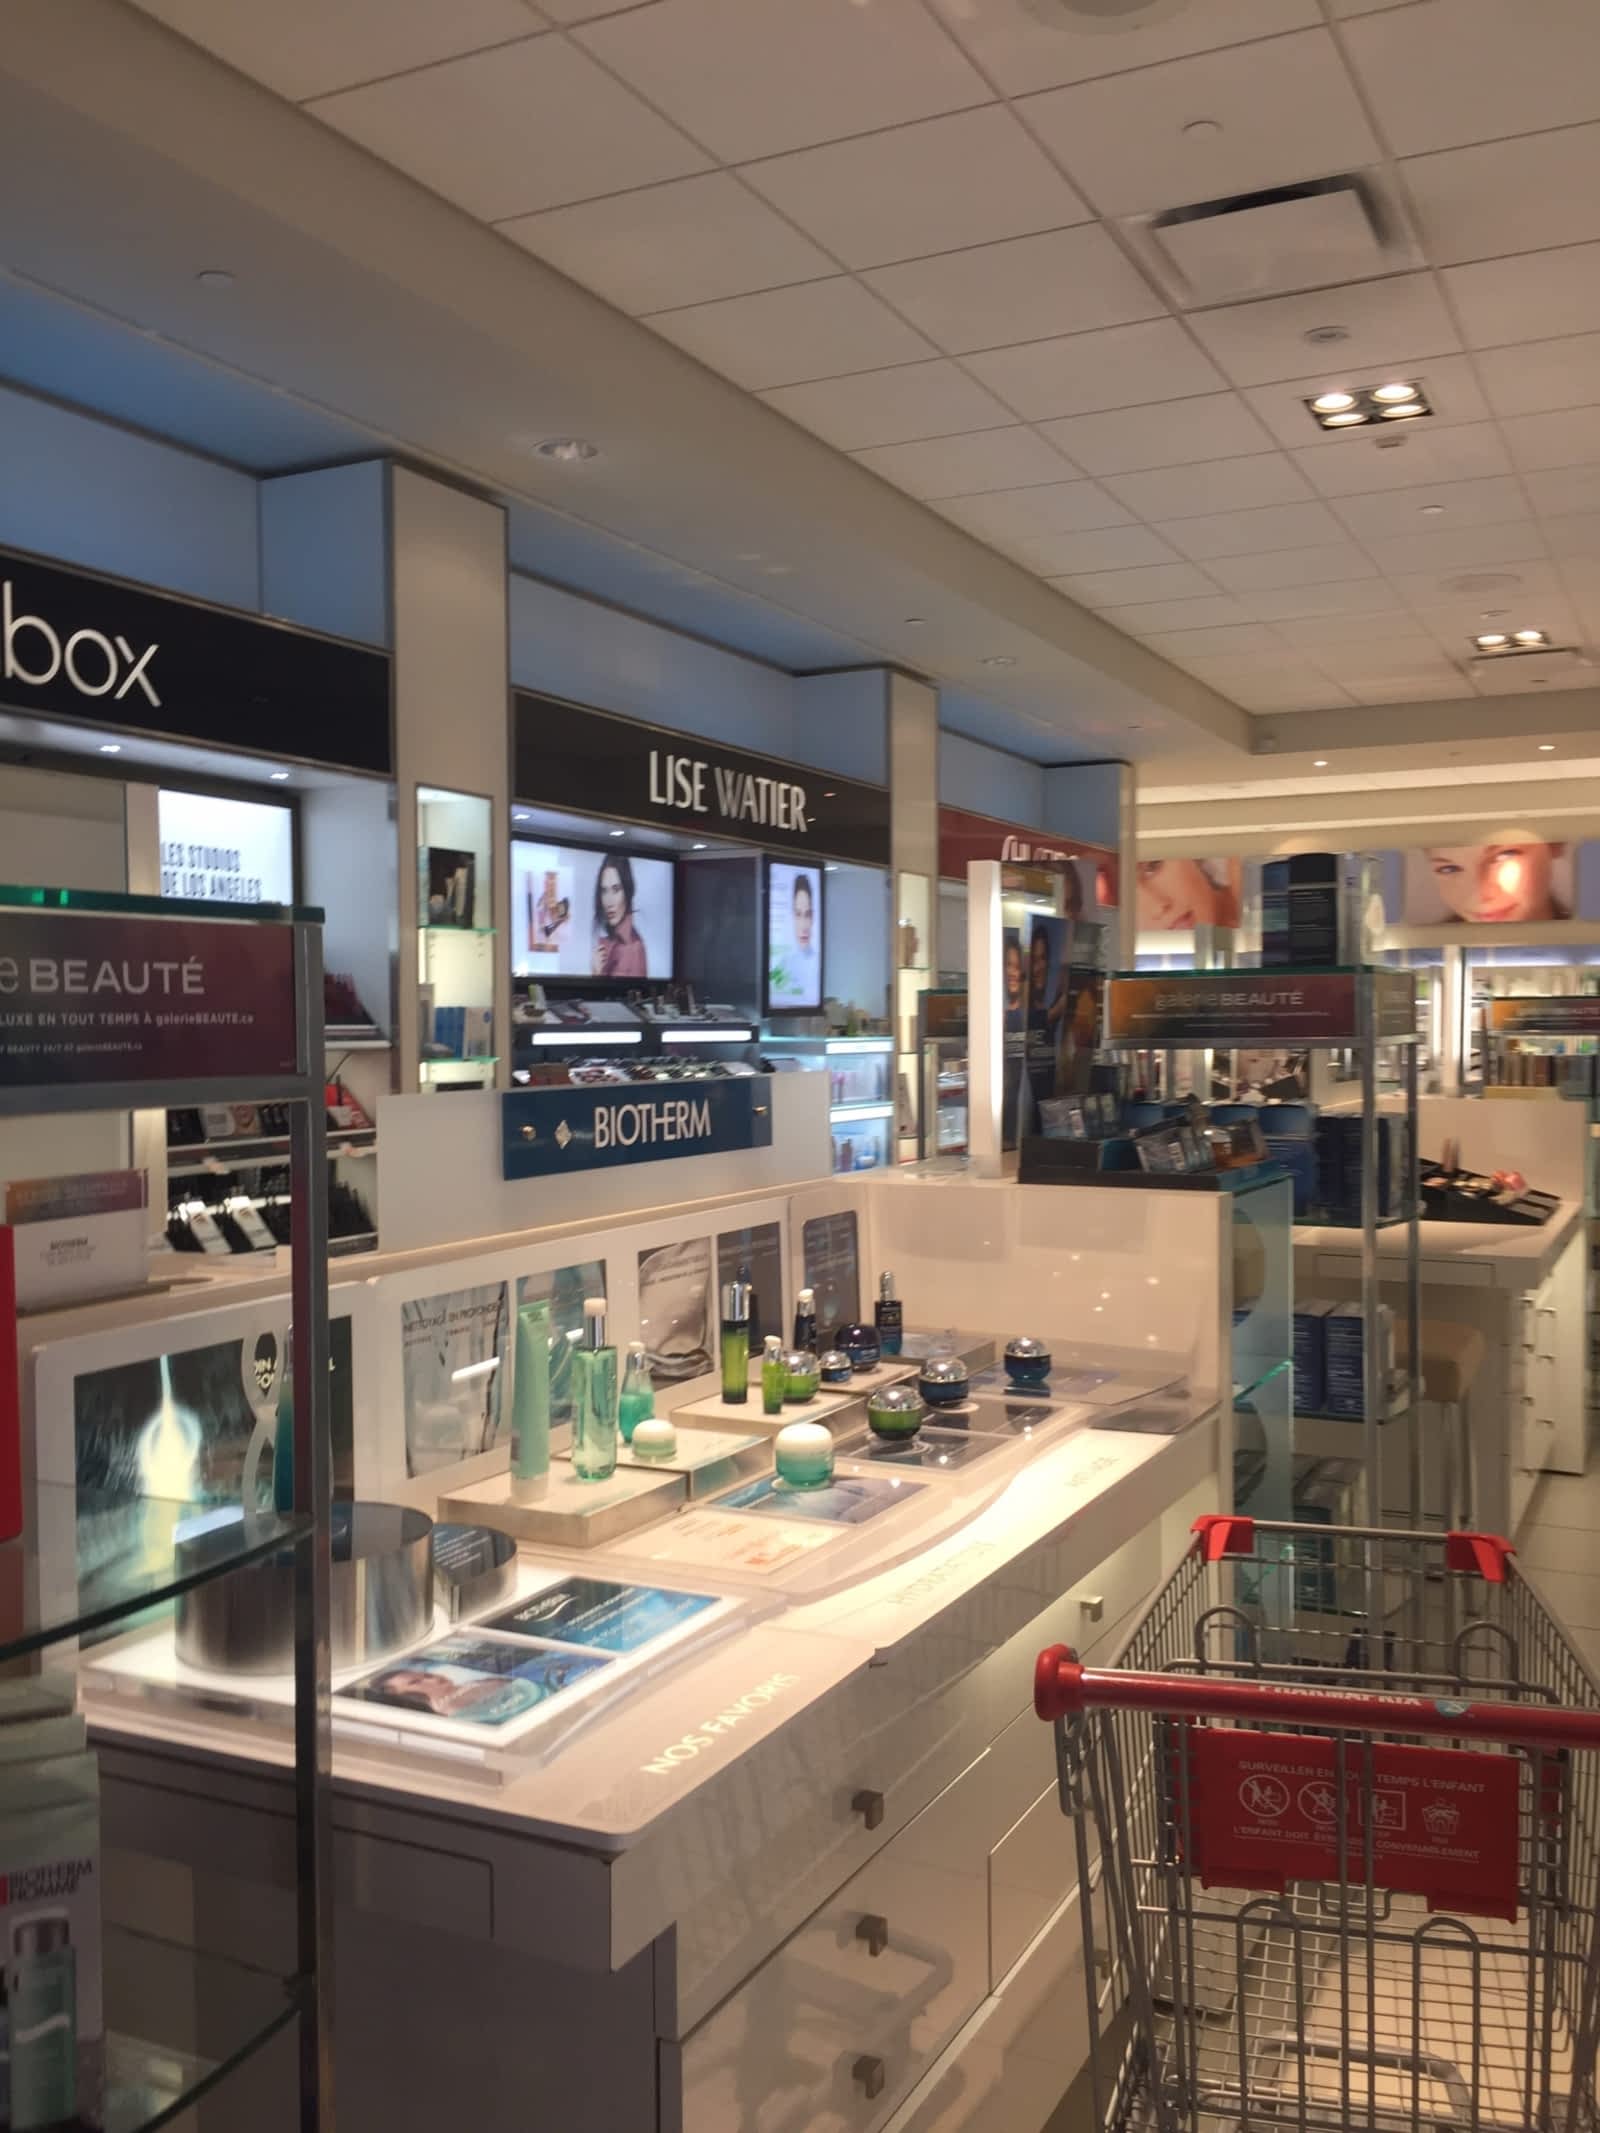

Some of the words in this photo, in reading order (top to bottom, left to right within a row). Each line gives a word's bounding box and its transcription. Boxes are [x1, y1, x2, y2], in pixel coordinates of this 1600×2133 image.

[650, 750, 709, 813] LISE
[713, 766, 808, 833] WATIER
[61, 1011, 95, 1026] TOUT
[100, 1011, 139, 1026] TEMPS
[594, 1098, 712, 1149] BIOTHERM
[640, 1733, 715, 1775] NOS
[699, 1671, 801, 1734] FAVORIS
[1375, 1773, 1420, 1787] TEMPS
[1423, 1776, 1488, 1793] L'ENFANT
